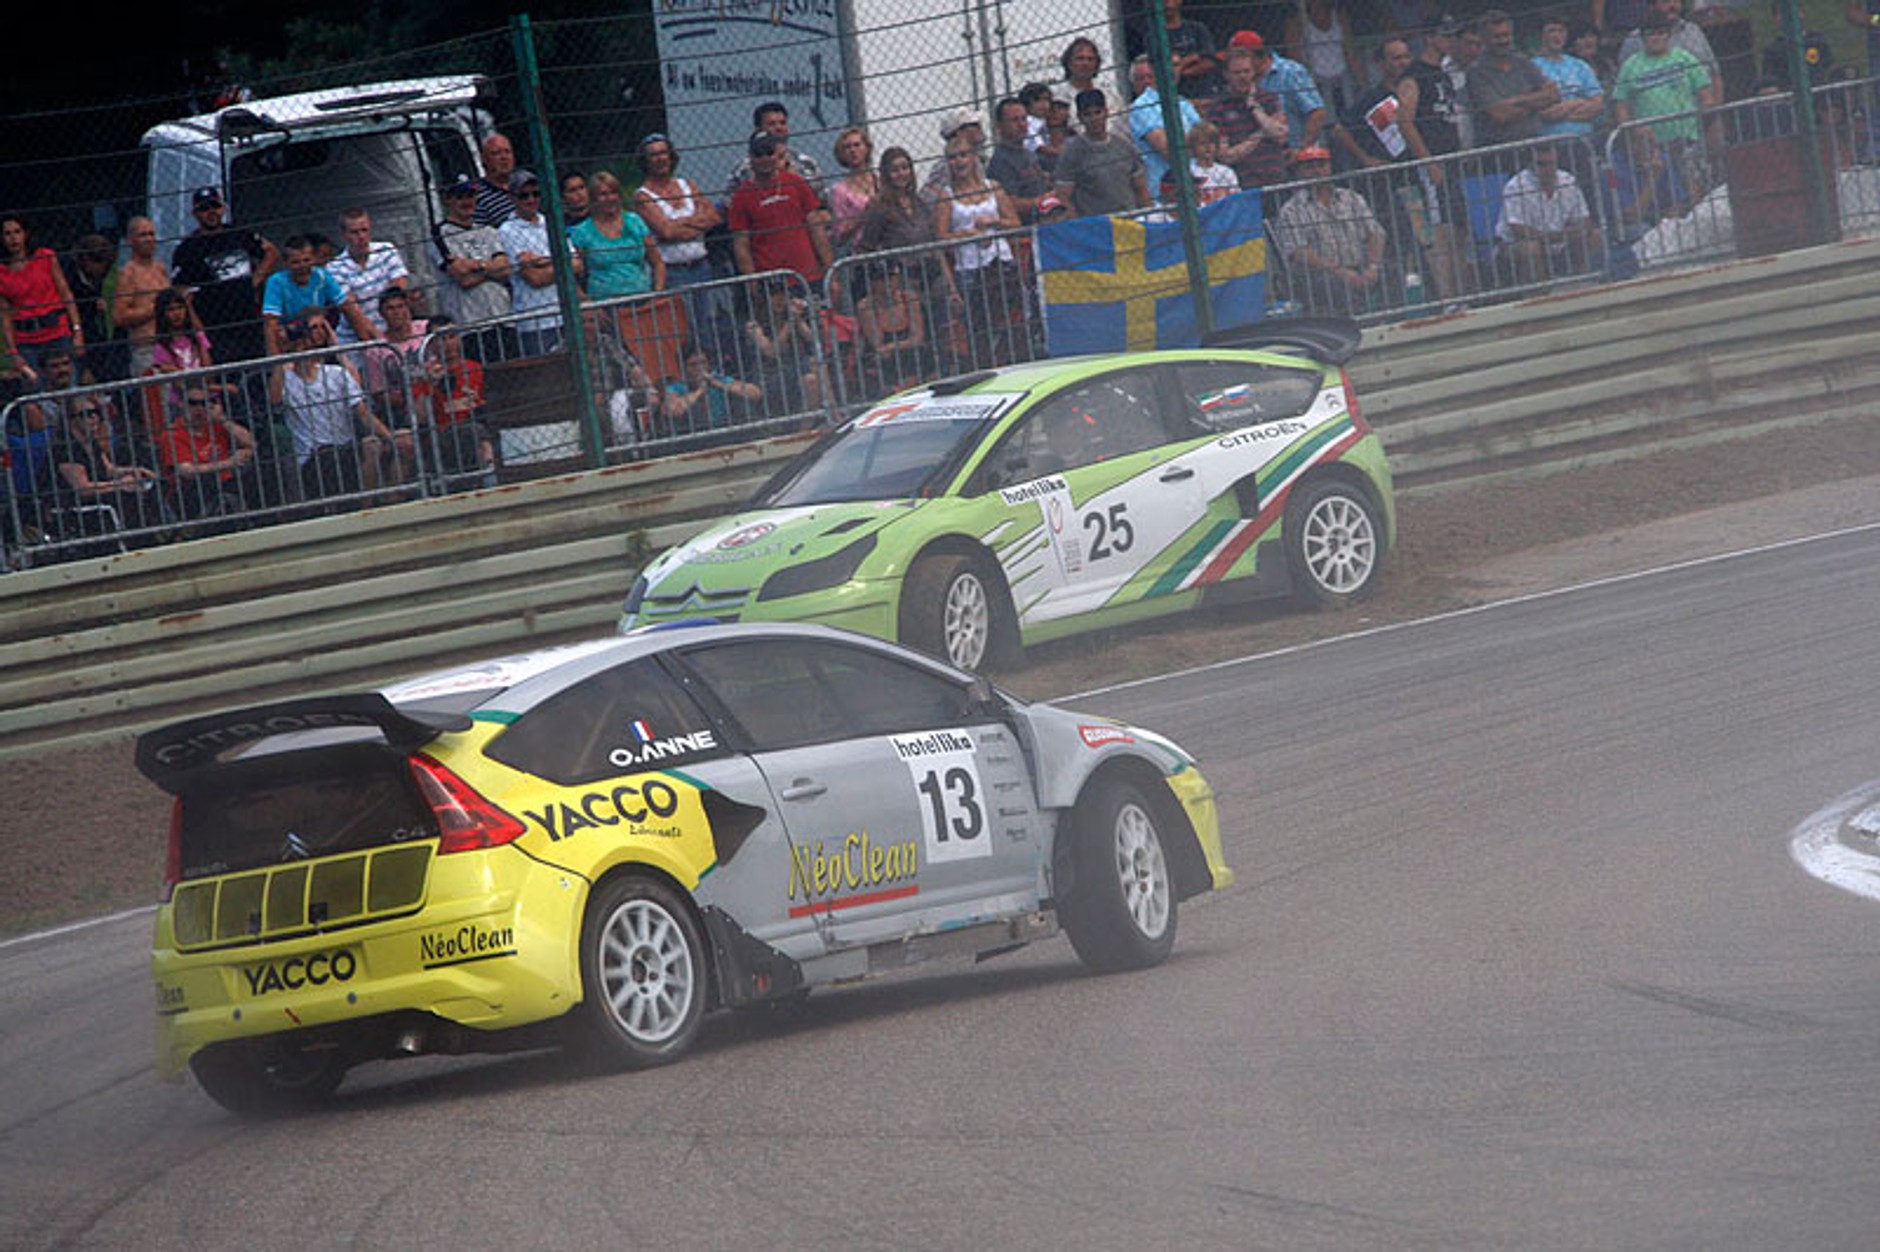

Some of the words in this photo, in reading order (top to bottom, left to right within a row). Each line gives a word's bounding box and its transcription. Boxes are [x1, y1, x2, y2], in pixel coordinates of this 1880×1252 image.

[1083, 502, 1134, 562] 25
[609, 730, 717, 767] O.ANNE
[523, 780, 678, 842] YACCO
[919, 766, 983, 843] 13
[788, 829, 918, 900] NéoClean
[420, 925, 514, 961] NéoClean
[244, 950, 357, 997] YACCO
